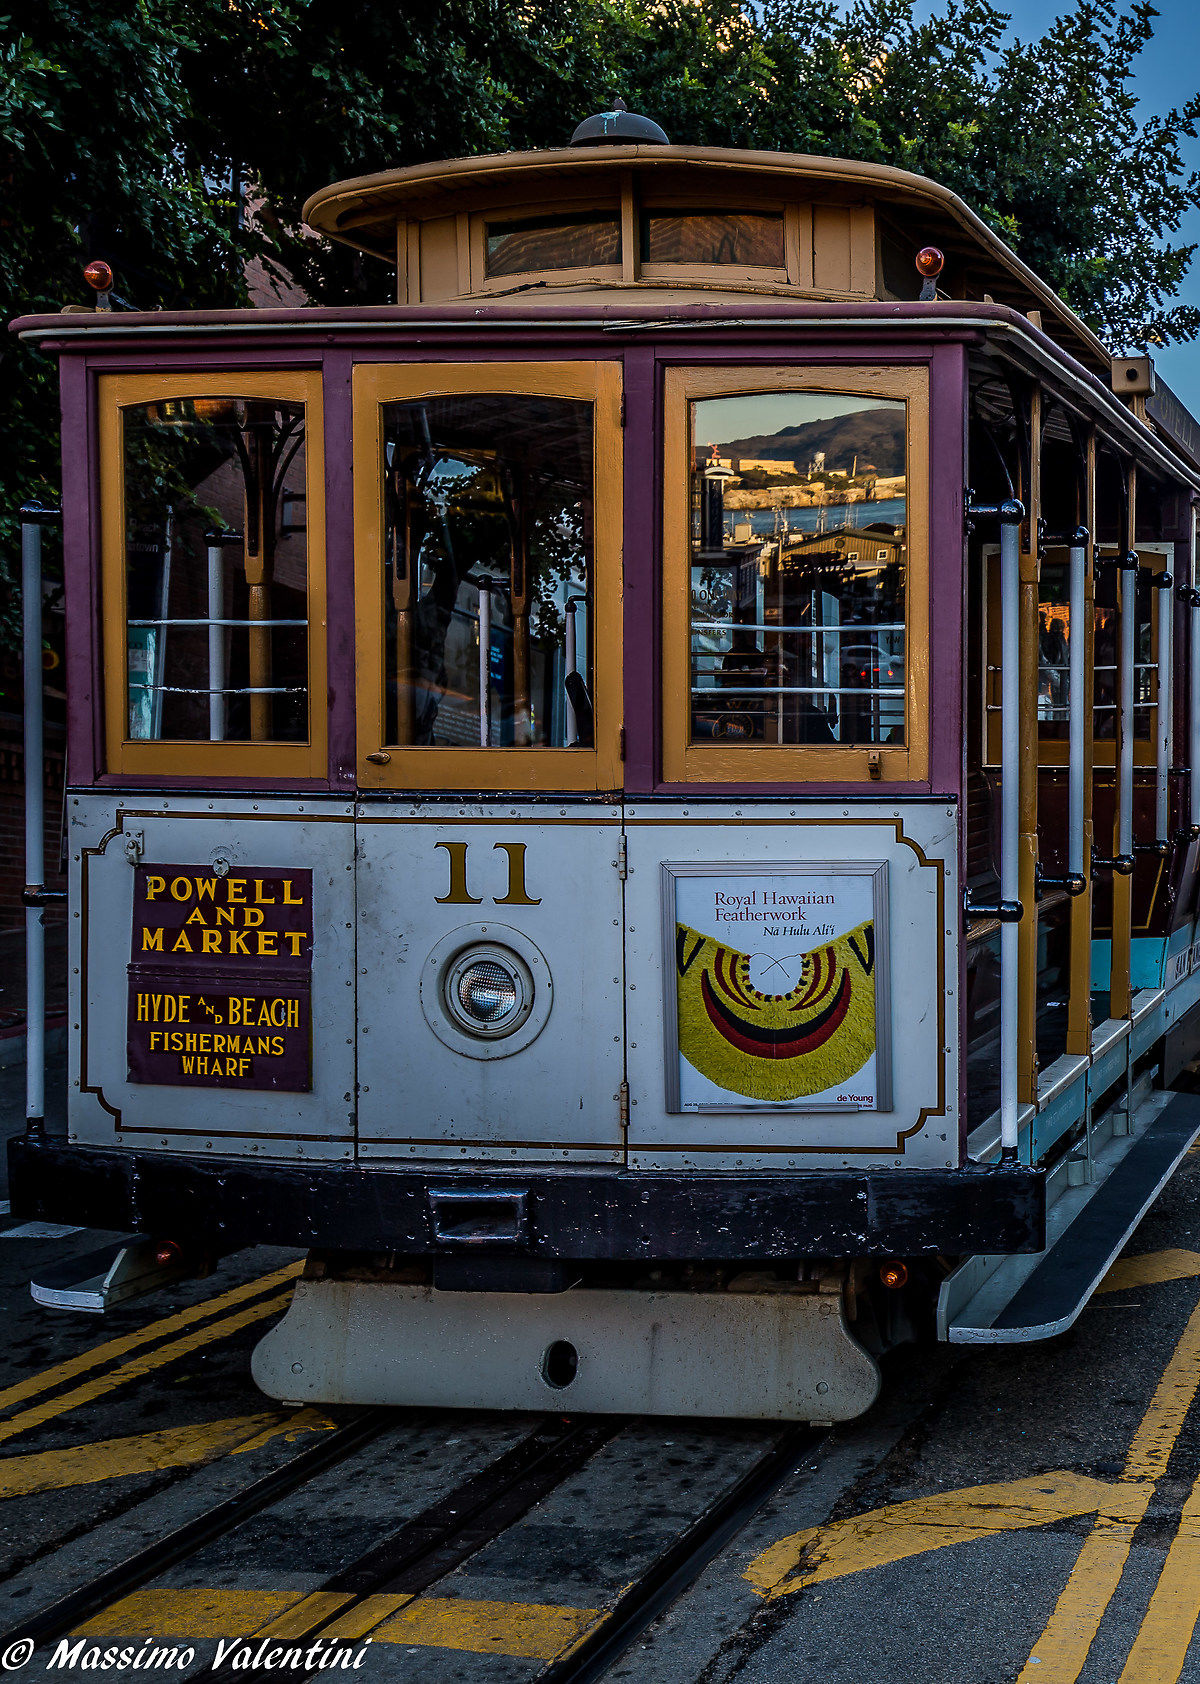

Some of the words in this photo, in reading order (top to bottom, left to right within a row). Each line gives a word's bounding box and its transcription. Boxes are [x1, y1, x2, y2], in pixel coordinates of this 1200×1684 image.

[434, 842, 542, 905] 11
[146, 876, 303, 905] POWELL
[714, 890, 756, 909] Royal
[762, 890, 836, 905] Hawaiian
[186, 907, 264, 927] AND
[715, 907, 807, 922] Featherwork
[141, 927, 307, 956] MARKET
[782, 925, 810, 936] Hulu
[137, 993, 191, 1023] HYDE
[197, 996, 223, 1024] AND
[228, 997, 299, 1028] BEACH
[149, 1031, 285, 1056] FISHERMANS
[181, 1055, 252, 1077] WHARF
[848, 1093, 873, 1103] Young
